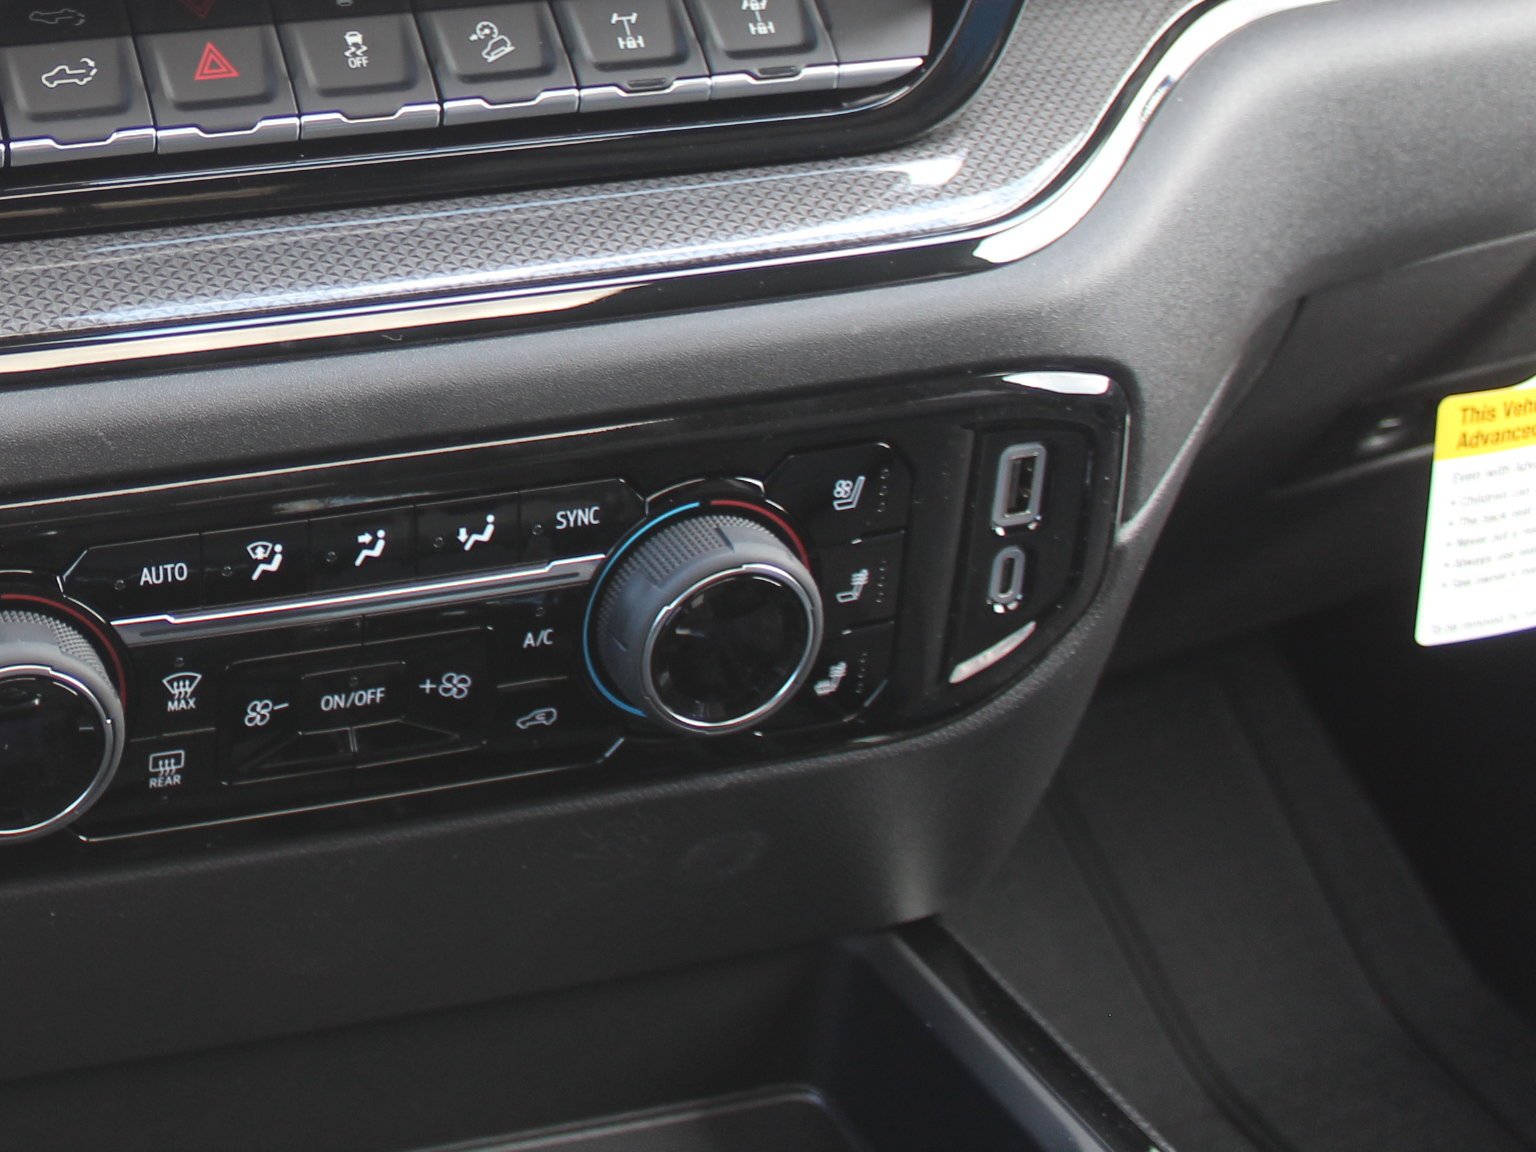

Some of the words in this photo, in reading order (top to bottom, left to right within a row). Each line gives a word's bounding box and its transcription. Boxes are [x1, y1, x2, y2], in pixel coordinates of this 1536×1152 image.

[347, 55, 370, 69] OFF
[1461, 405, 1496, 426] This
[555, 506, 600, 530] SYNC
[139, 563, 188, 586] AUTO
[523, 628, 554, 648] A/C
[166, 698, 196, 711] MAX
[320, 687, 386, 711] ON/OFF
[148, 774, 182, 788] REAR
